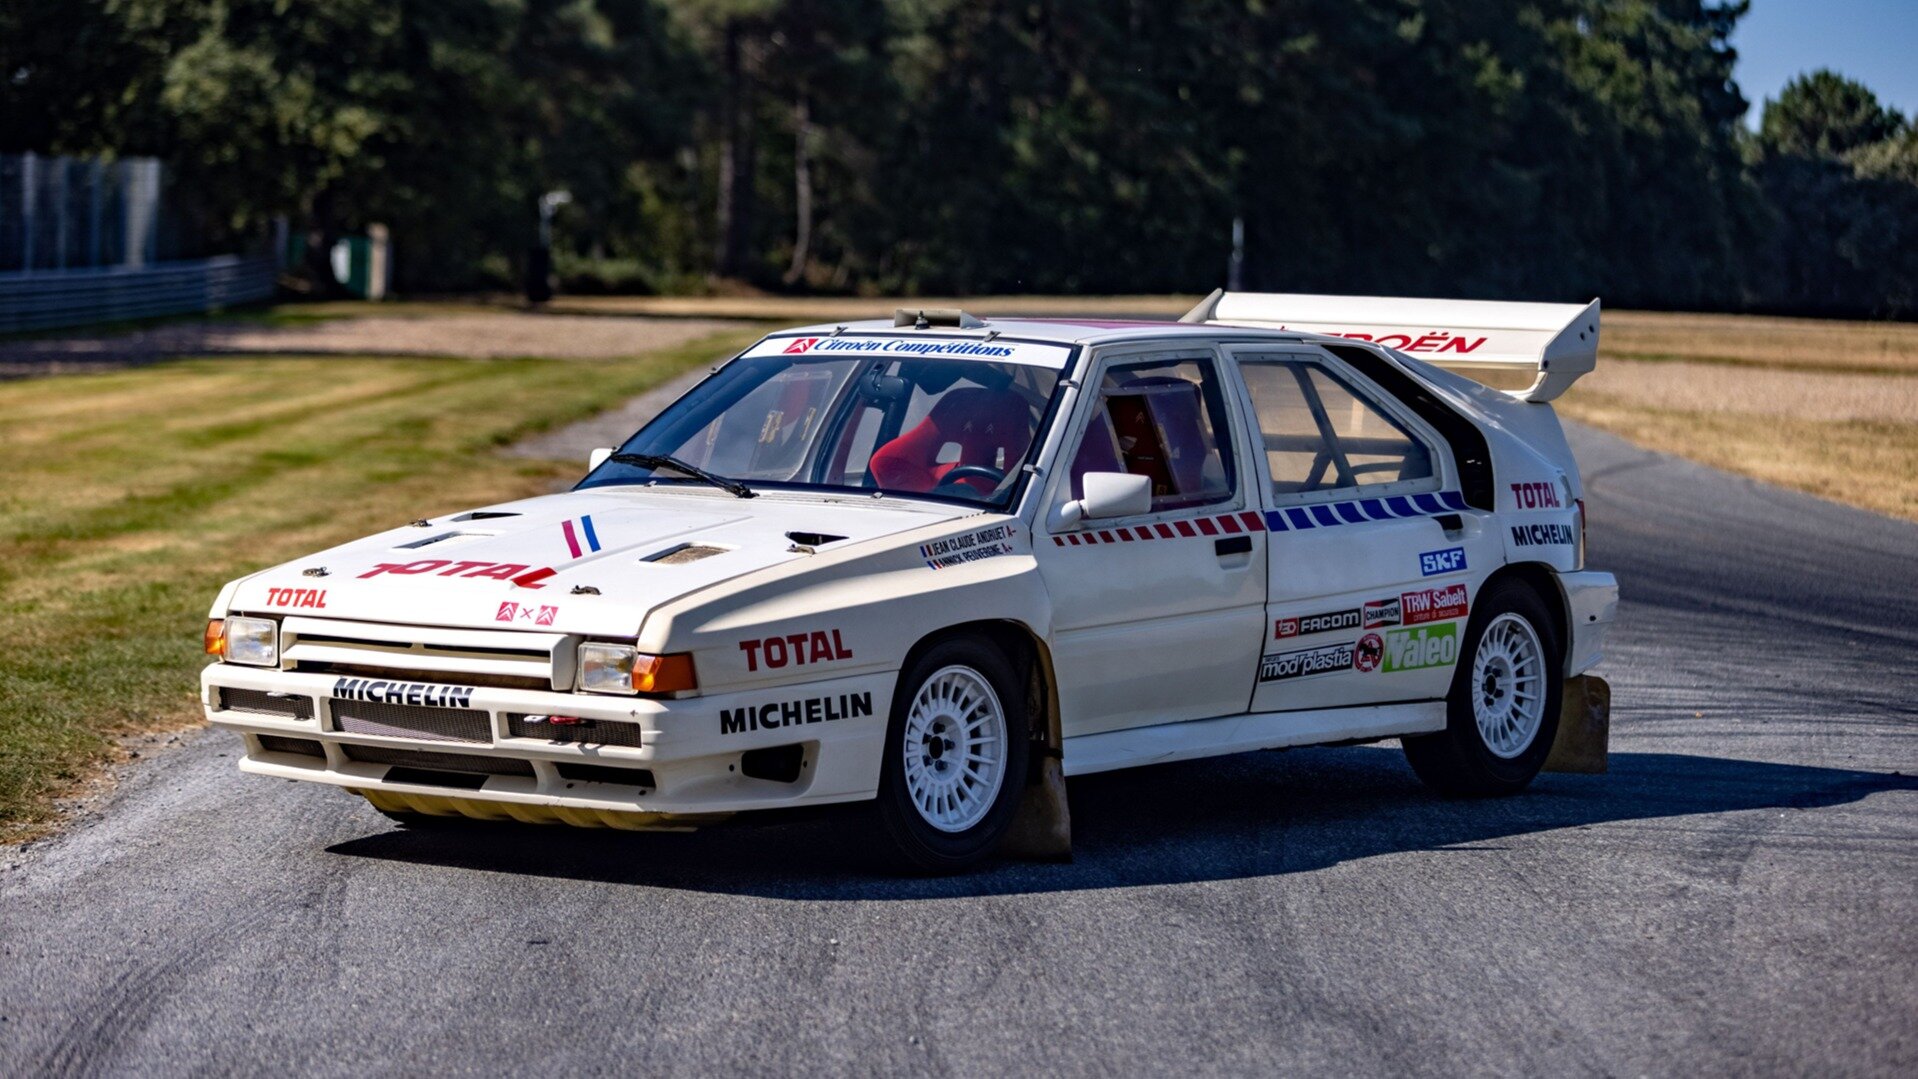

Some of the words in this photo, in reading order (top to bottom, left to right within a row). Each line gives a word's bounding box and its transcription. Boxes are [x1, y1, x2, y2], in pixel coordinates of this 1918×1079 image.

[814, 338, 882, 352] Citroën
[882, 339, 1016, 358] Compétitions
[1510, 482, 1560, 509] TOTAL
[932, 539, 950, 556] JEAN
[949, 533, 975, 551] CLAUDE
[976, 526, 1006, 545] ANDRUET
[1511, 524, 1574, 546] MICHELIN
[355, 559, 557, 590] TOTAL
[1423, 550, 1463, 573] SKF
[266, 588, 328, 608] TOTAL
[1404, 592, 1431, 613] TRW
[1433, 587, 1467, 608] Sabelt
[1301, 612, 1360, 632] FACOM
[1366, 606, 1399, 620] CHAMPION
[739, 629, 853, 672] TOTAL
[1386, 629, 1455, 669] Valeo
[333, 676, 474, 708] MICHELIN
[720, 692, 873, 735] MICHELIN
